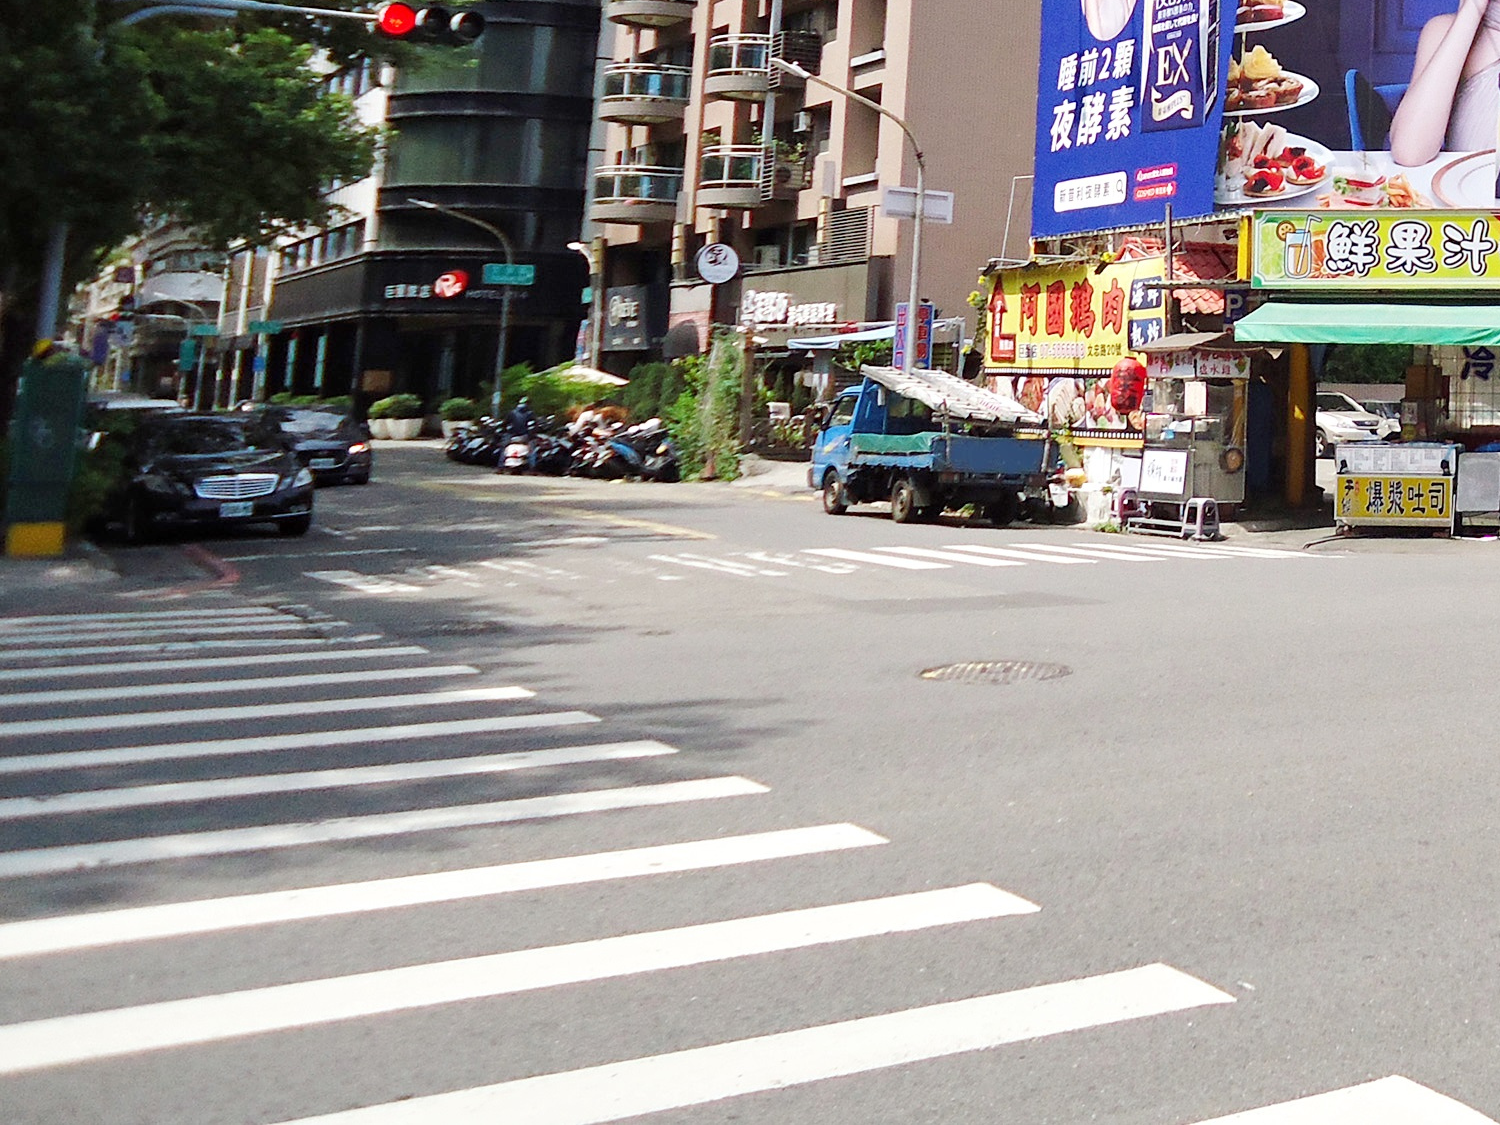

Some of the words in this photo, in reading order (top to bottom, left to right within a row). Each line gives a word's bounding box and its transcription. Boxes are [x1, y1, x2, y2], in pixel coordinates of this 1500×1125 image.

[1057, 39, 1135, 91] 睡前2顆
[1156, 38, 1193, 87] EX
[1050, 85, 1135, 152] 夜酵素
[1324, 217, 1499, 276] 鮮果汁
[1020, 277, 1125, 338] 阿國鵝肉
[1366, 480, 1445, 515] 爆漿吐司
